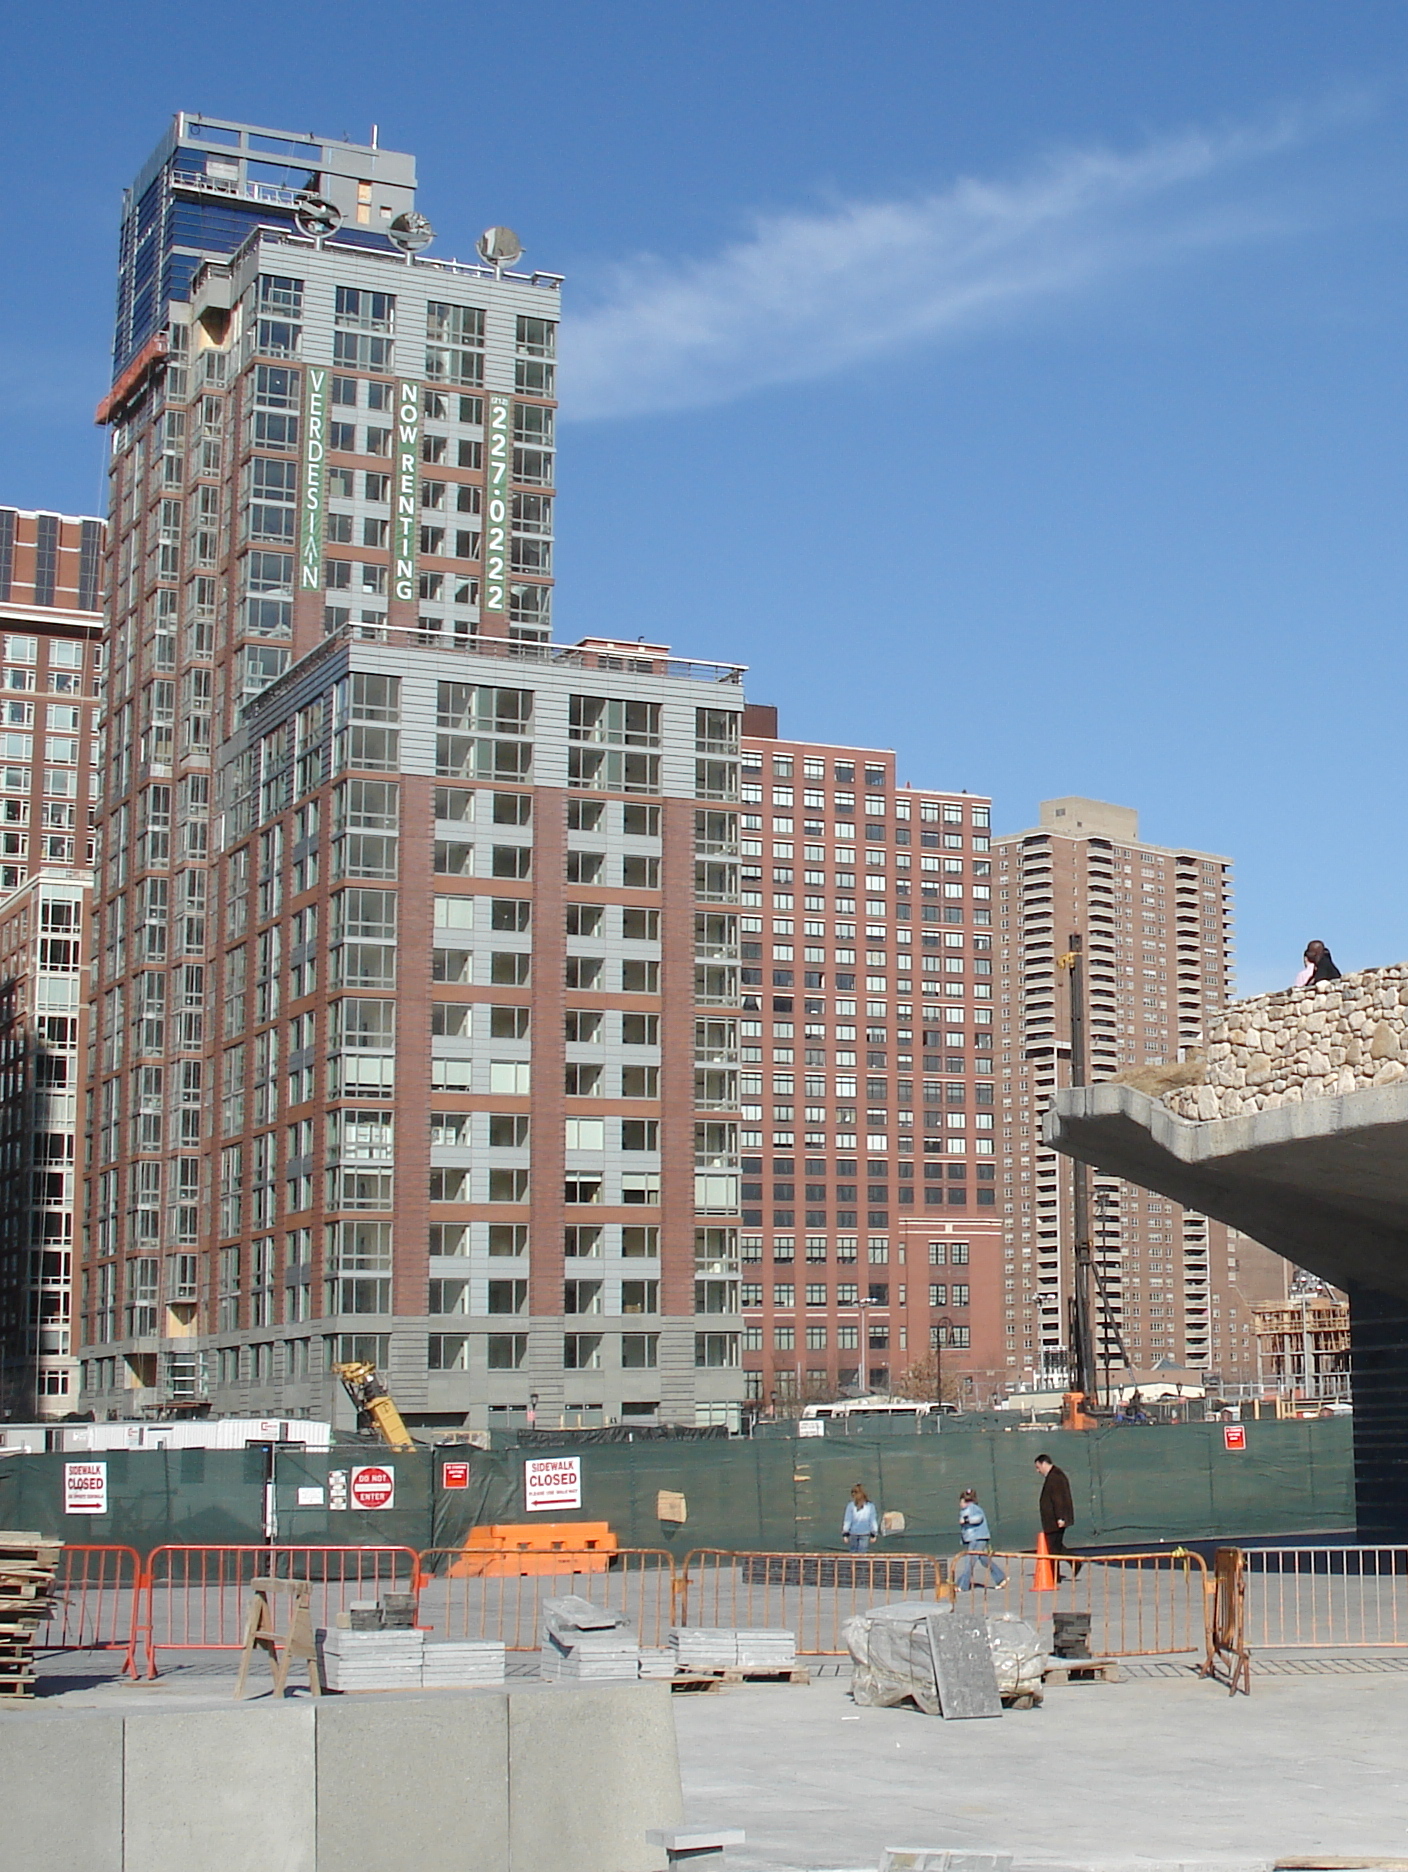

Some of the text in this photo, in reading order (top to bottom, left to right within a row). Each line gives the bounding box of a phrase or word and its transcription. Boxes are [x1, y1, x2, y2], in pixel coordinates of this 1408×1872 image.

[302, 369, 325, 589] VERDESIAN
[396, 383, 418, 600] NOW RENTING
[68, 1465, 101, 1475] SIDEWALK
[531, 1460, 575, 1472] SIDEWALK
[68, 1477, 104, 1490] CLOSED
[371, 1474, 387, 1482] NOT
[529, 1473, 577, 1487] CLOSED
[360, 1493, 385, 1501] ENTER
